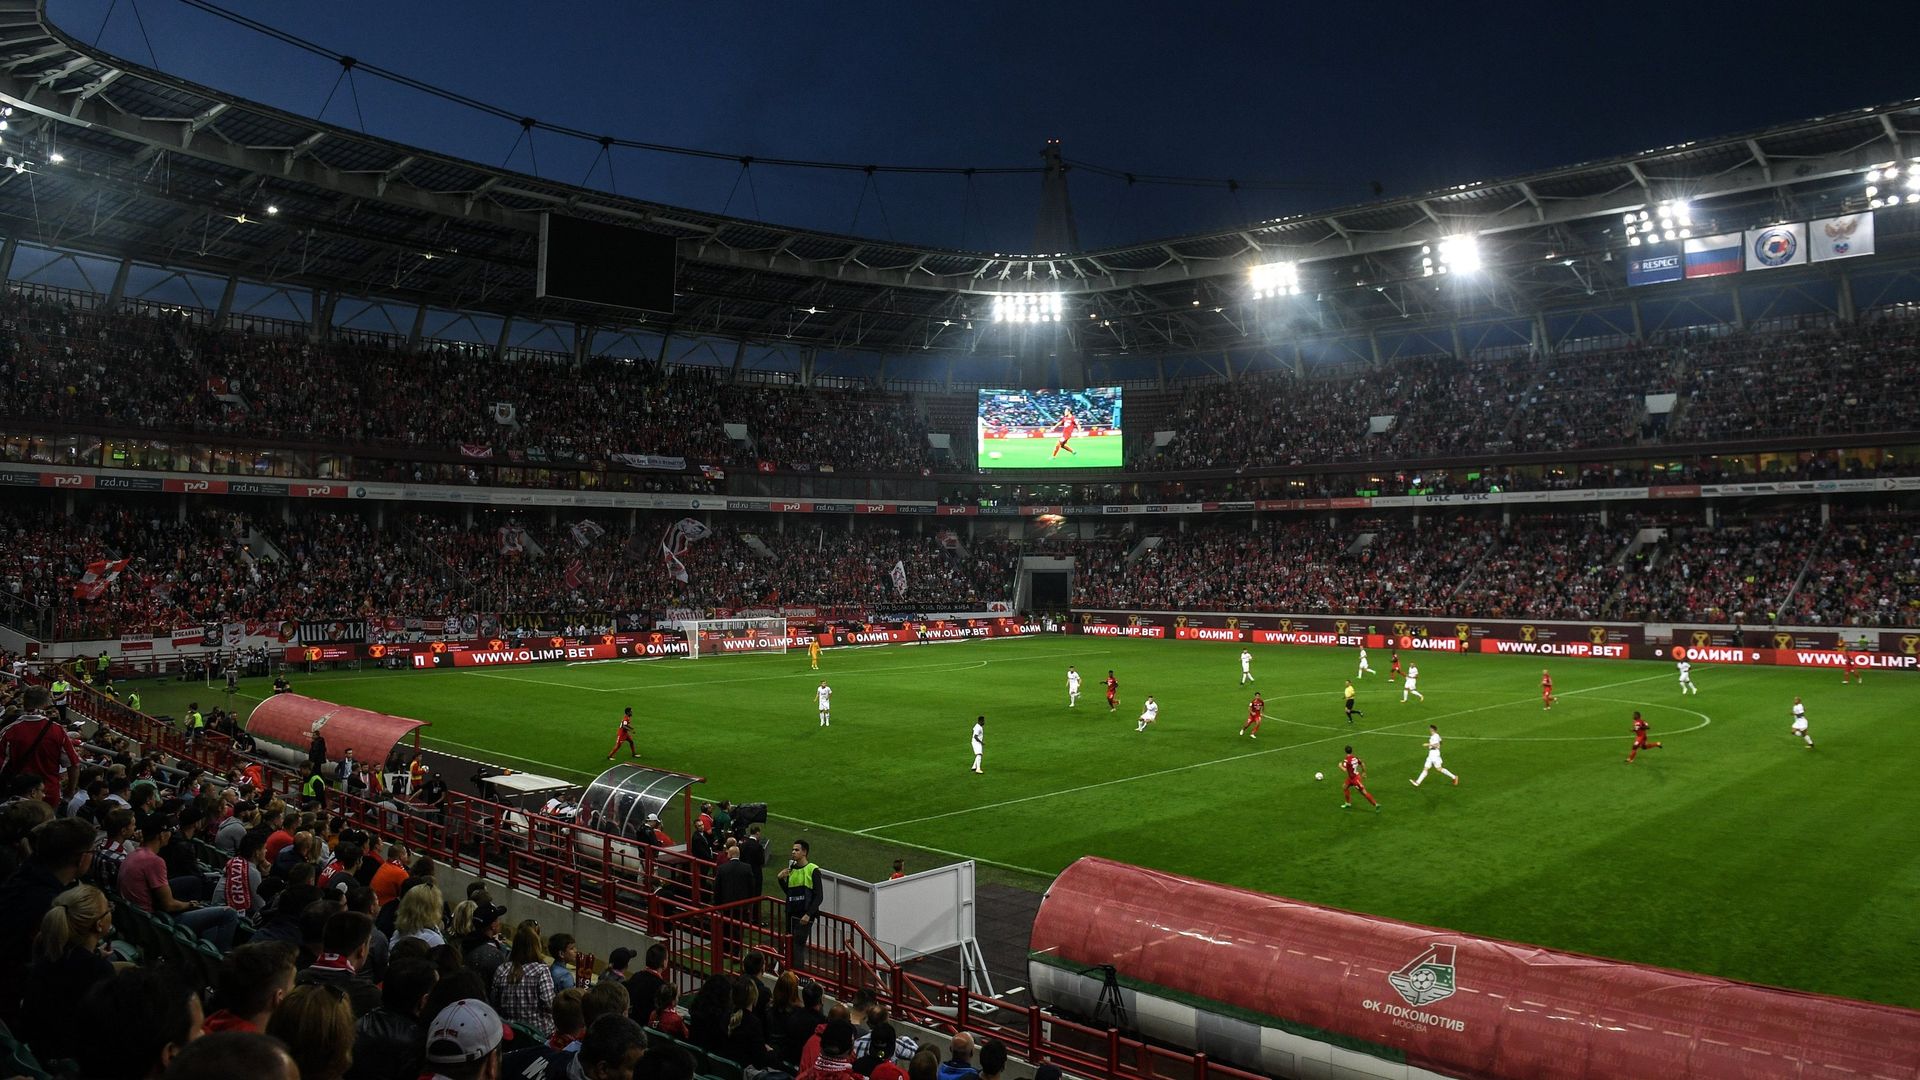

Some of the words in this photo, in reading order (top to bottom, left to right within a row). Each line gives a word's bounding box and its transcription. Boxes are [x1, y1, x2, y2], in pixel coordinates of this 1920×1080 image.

[1642, 257, 1678, 270] RESPECT
[100, 478, 129, 488] rzd.ru
[232, 483, 259, 493] rzd.ru
[1083, 625, 1161, 637] WWW.OLIMP.BET
[1199, 630, 1233, 640] ОЛИМП
[723, 637, 815, 649] WWW.OLIMP.BET
[857, 632, 889, 643] ОЛИМП
[1265, 632, 1363, 645] WWW.OLIMP.BET
[646, 642, 688, 654] ОЛИМП
[1412, 639, 1456, 649] ОЛИМП
[1496, 641, 1623, 657] WWW.OLIMP.BET
[472, 648, 594, 663] WWW.OLIMP.BET
[1687, 649, 1743, 662] ОЛИМП
[1362, 999, 1380, 1012] ФК
[1383, 1003, 1465, 1032] ЛОКОМОТИВ
[1392, 1018, 1427, 1033] МОСКВА
